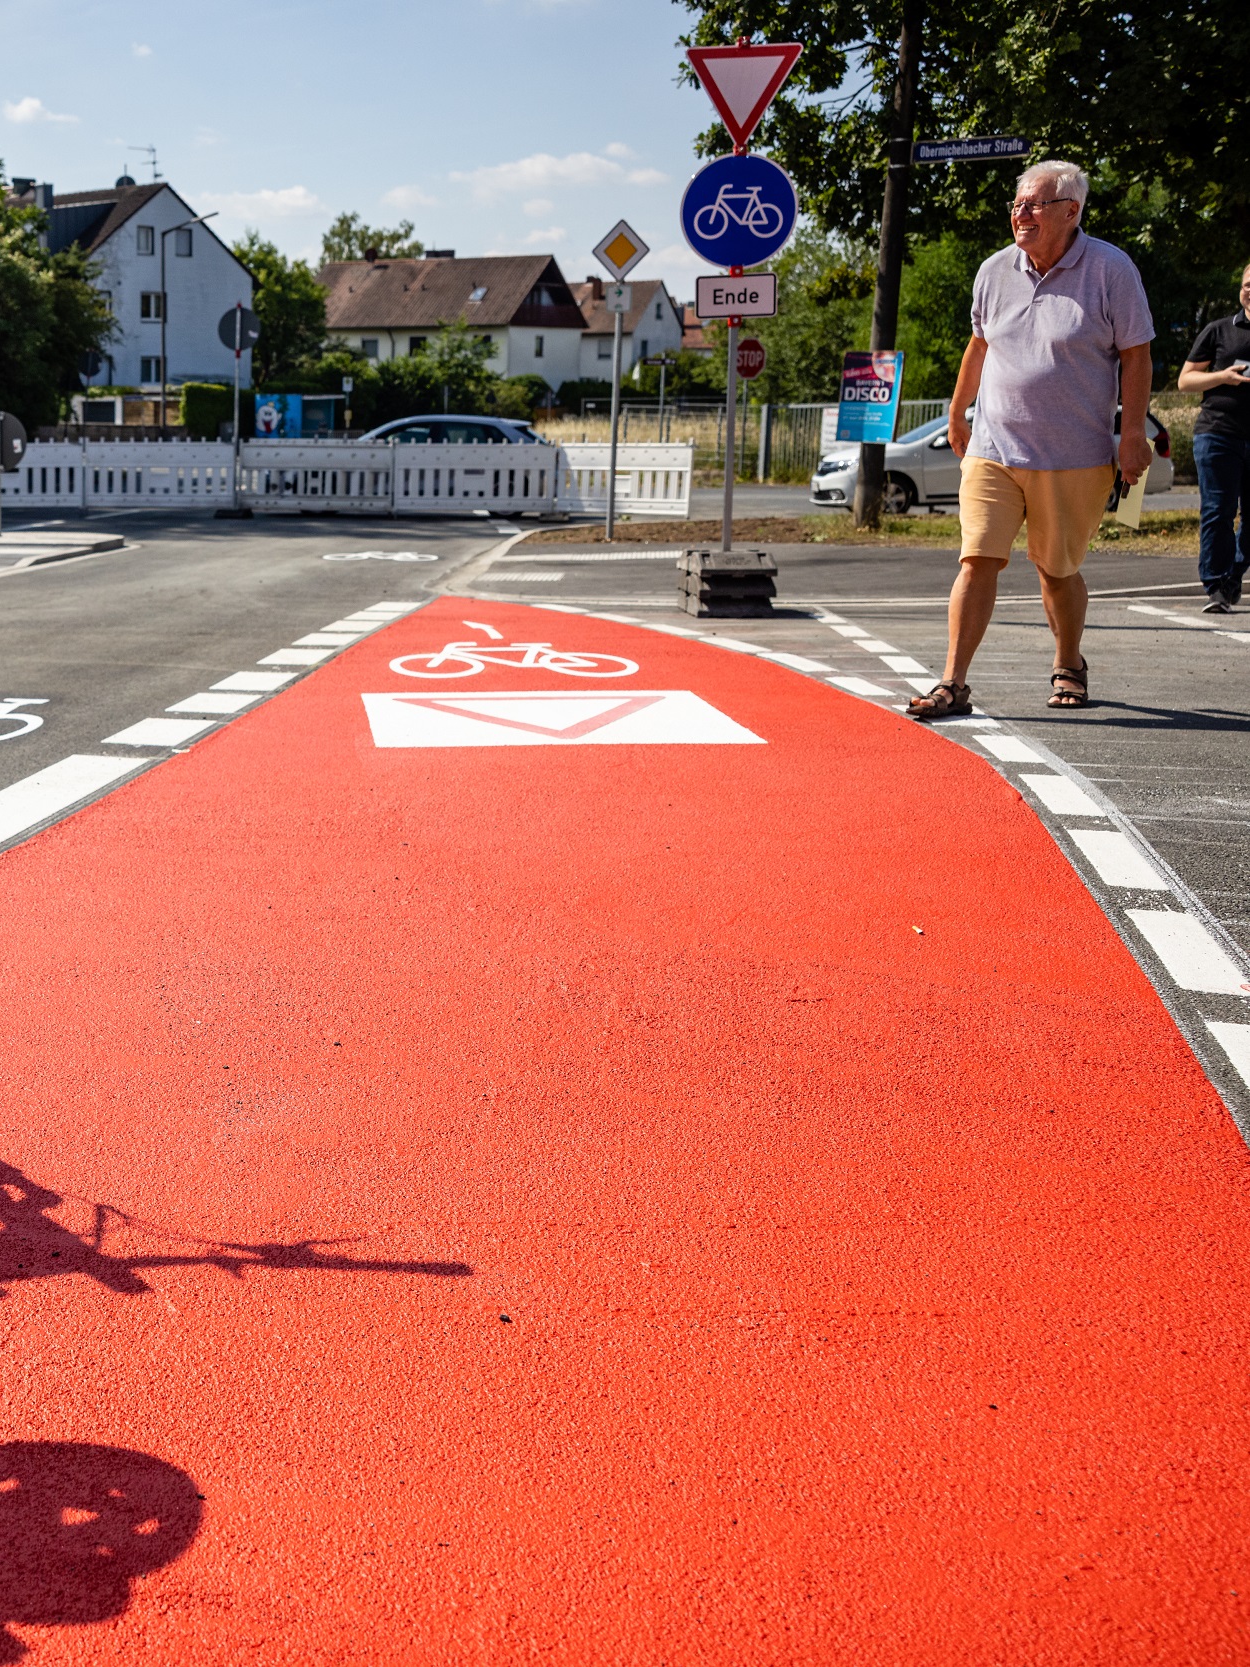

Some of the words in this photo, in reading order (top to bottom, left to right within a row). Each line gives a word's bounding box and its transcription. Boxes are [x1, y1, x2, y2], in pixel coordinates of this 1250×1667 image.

[920, 142, 991, 158] Obermichelbacher
[994, 139, 1023, 153] Straße
[713, 287, 759, 305] Ende
[737, 350, 763, 367] STOP
[844, 386, 890, 402] DISCO
